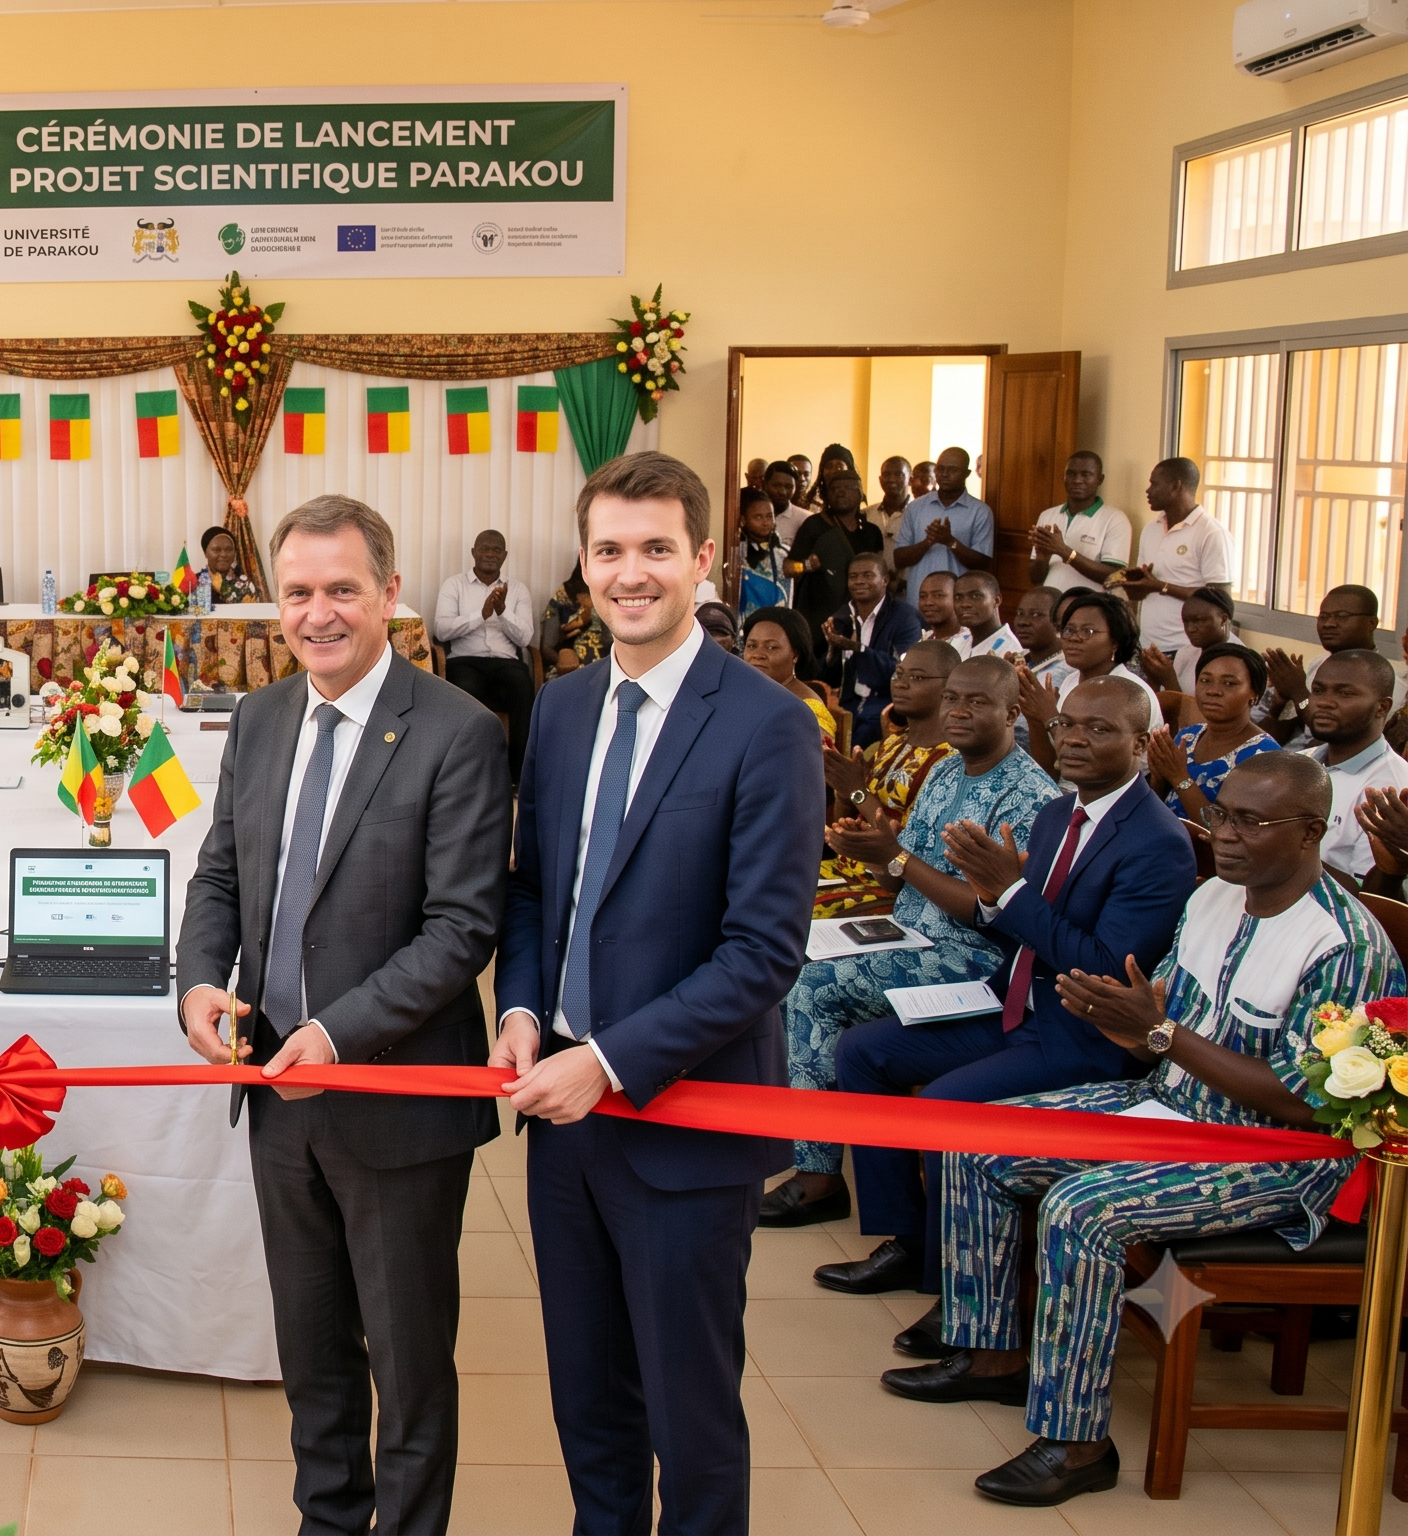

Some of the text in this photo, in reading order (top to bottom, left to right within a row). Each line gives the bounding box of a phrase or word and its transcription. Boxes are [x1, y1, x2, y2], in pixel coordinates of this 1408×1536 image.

[16, 118, 516, 153] CÉRÉMONIE DE LANCEMENT
[10, 165, 145, 194] PROJET
[153, 163, 398, 194] SCIENTIFIQUE
[410, 160, 584, 188] PARAKOU
[4, 226, 90, 240] UNIVERSITÉ
[4, 245, 99, 257] DE PARAKOU
